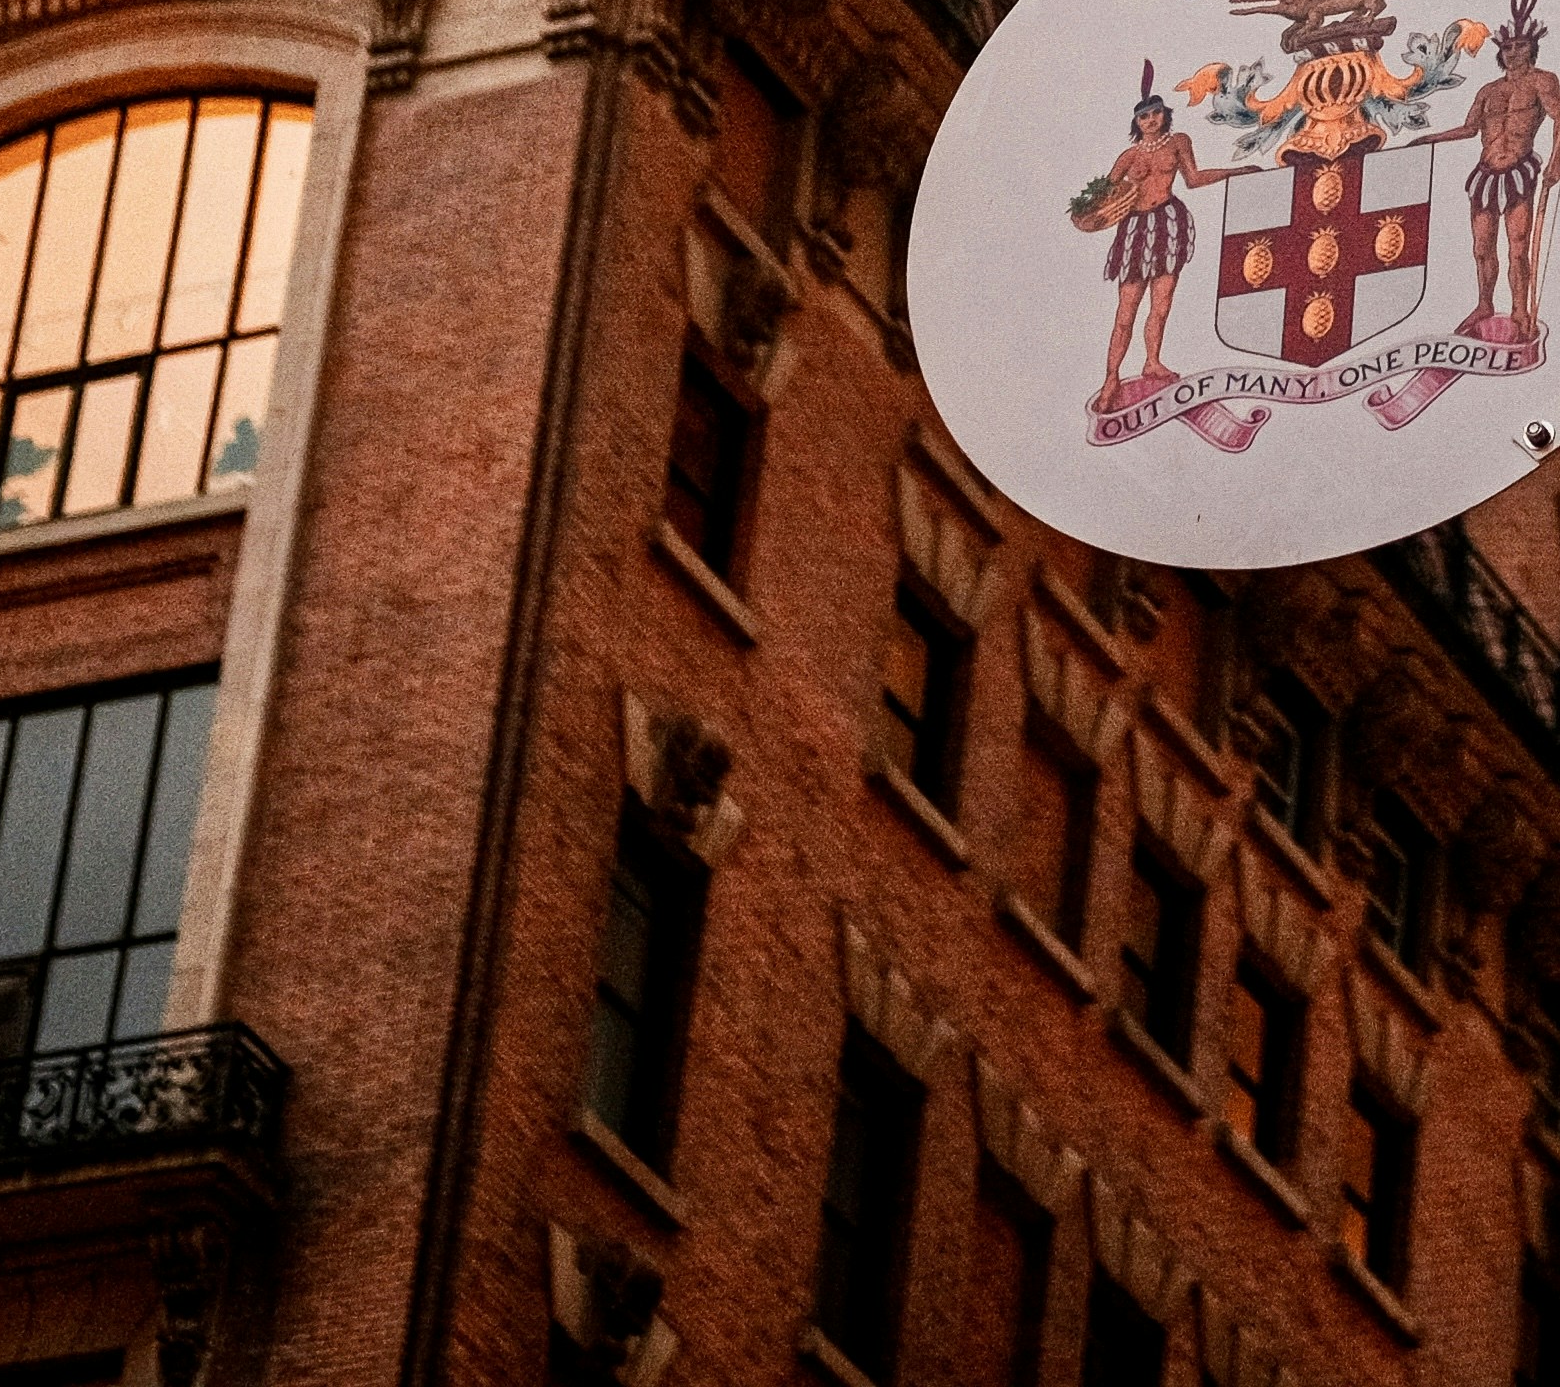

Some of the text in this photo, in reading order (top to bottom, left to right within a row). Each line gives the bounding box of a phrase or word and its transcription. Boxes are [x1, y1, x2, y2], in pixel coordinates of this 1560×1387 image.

[1101, 341, 1523, 438] OUT OF MANY, ONE PEOPLE
